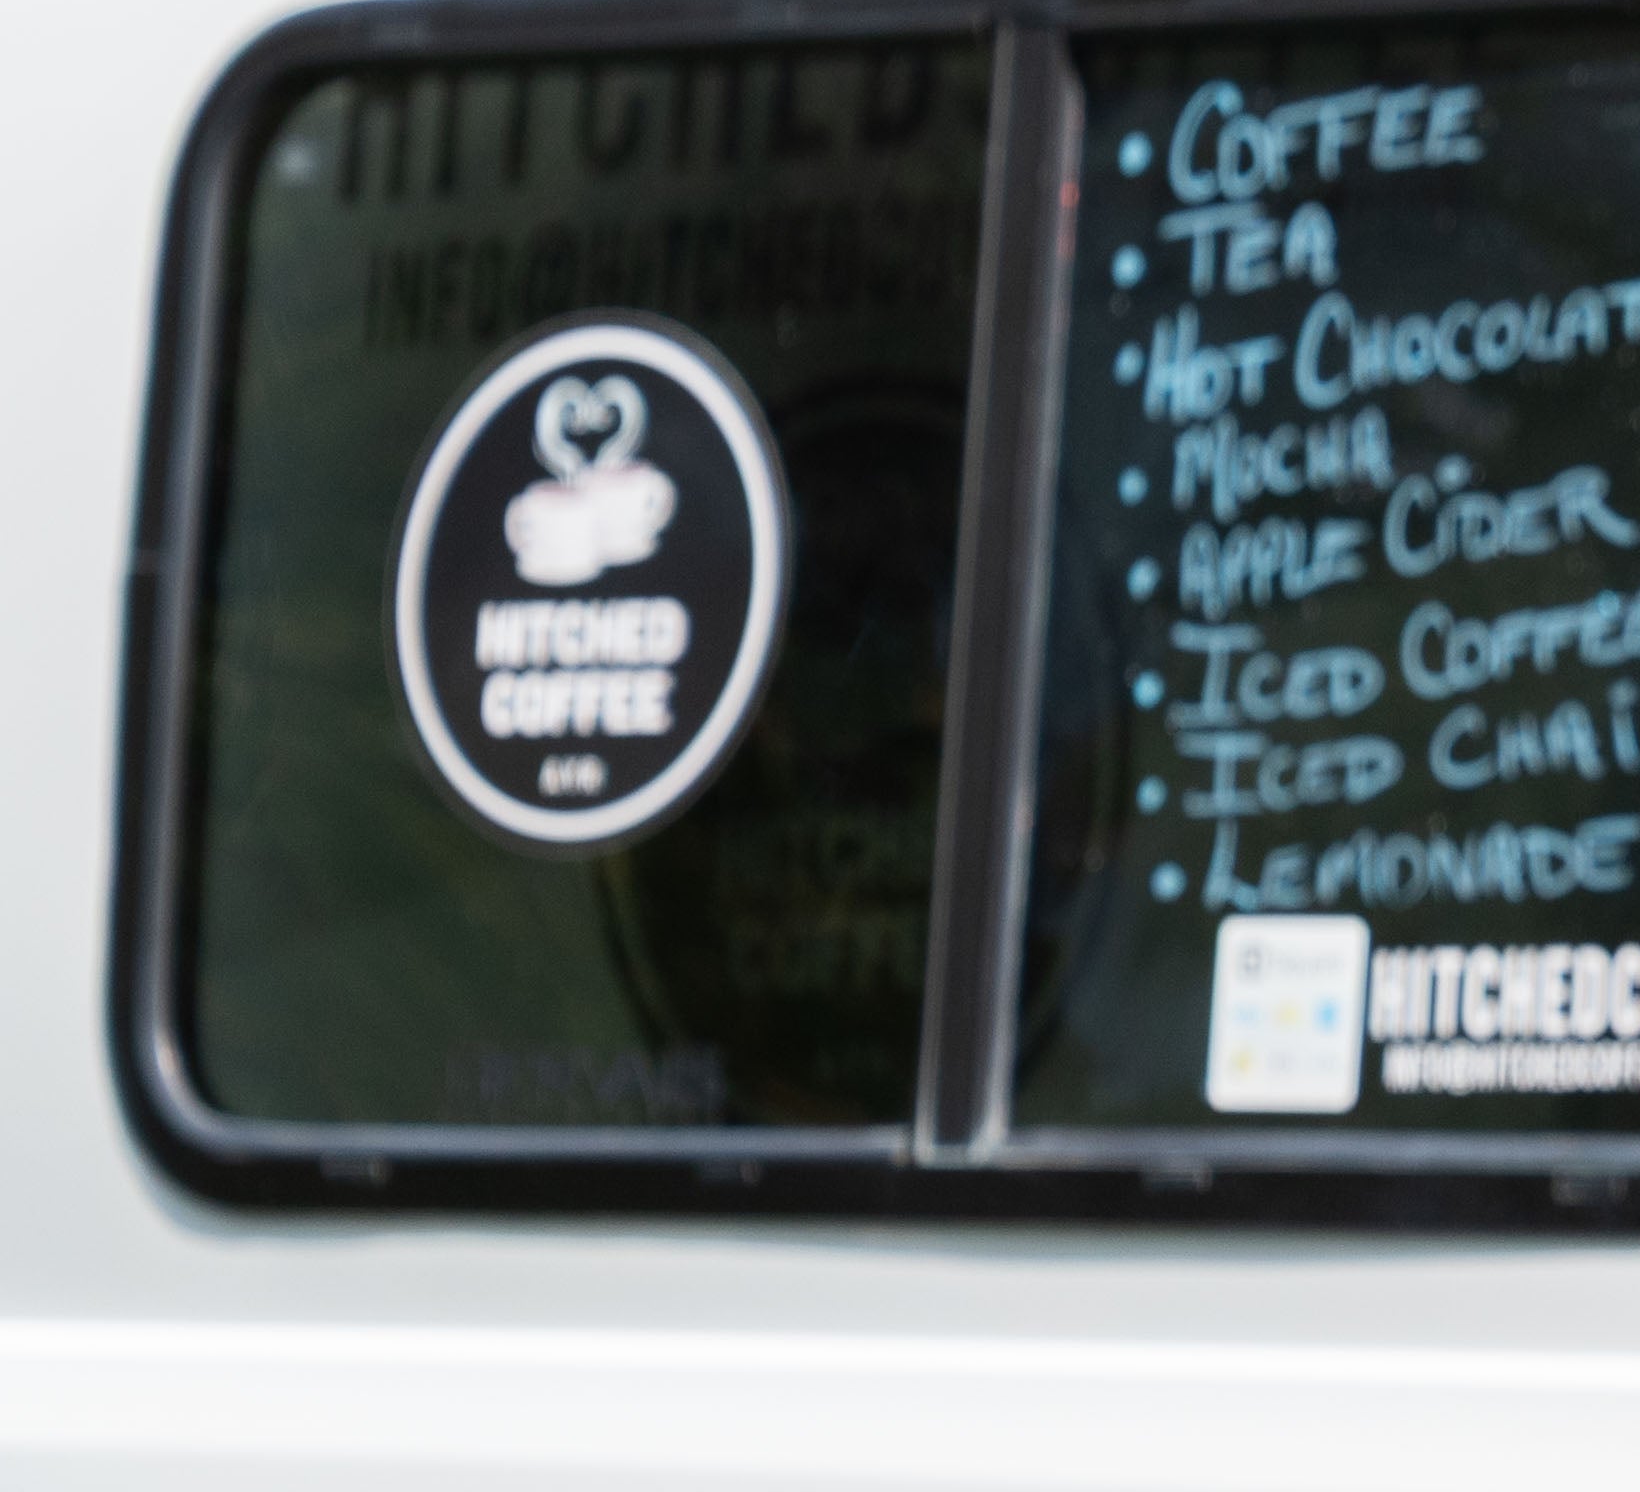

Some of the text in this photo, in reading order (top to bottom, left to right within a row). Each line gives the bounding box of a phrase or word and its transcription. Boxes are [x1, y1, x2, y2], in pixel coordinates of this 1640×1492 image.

[1169, 79, 1485, 202] COFFEE
[1157, 201, 1337, 295] TEA
[1144, 304, 1285, 423] HOT
[1172, 406, 1394, 522] MOCHA
[1176, 514, 1370, 621] APPLE
[475, 596, 690, 671] HITCHED
[1166, 621, 1383, 730] ICED
[479, 668, 677, 739] COFFEE
[1173, 730, 1402, 820] ICED
